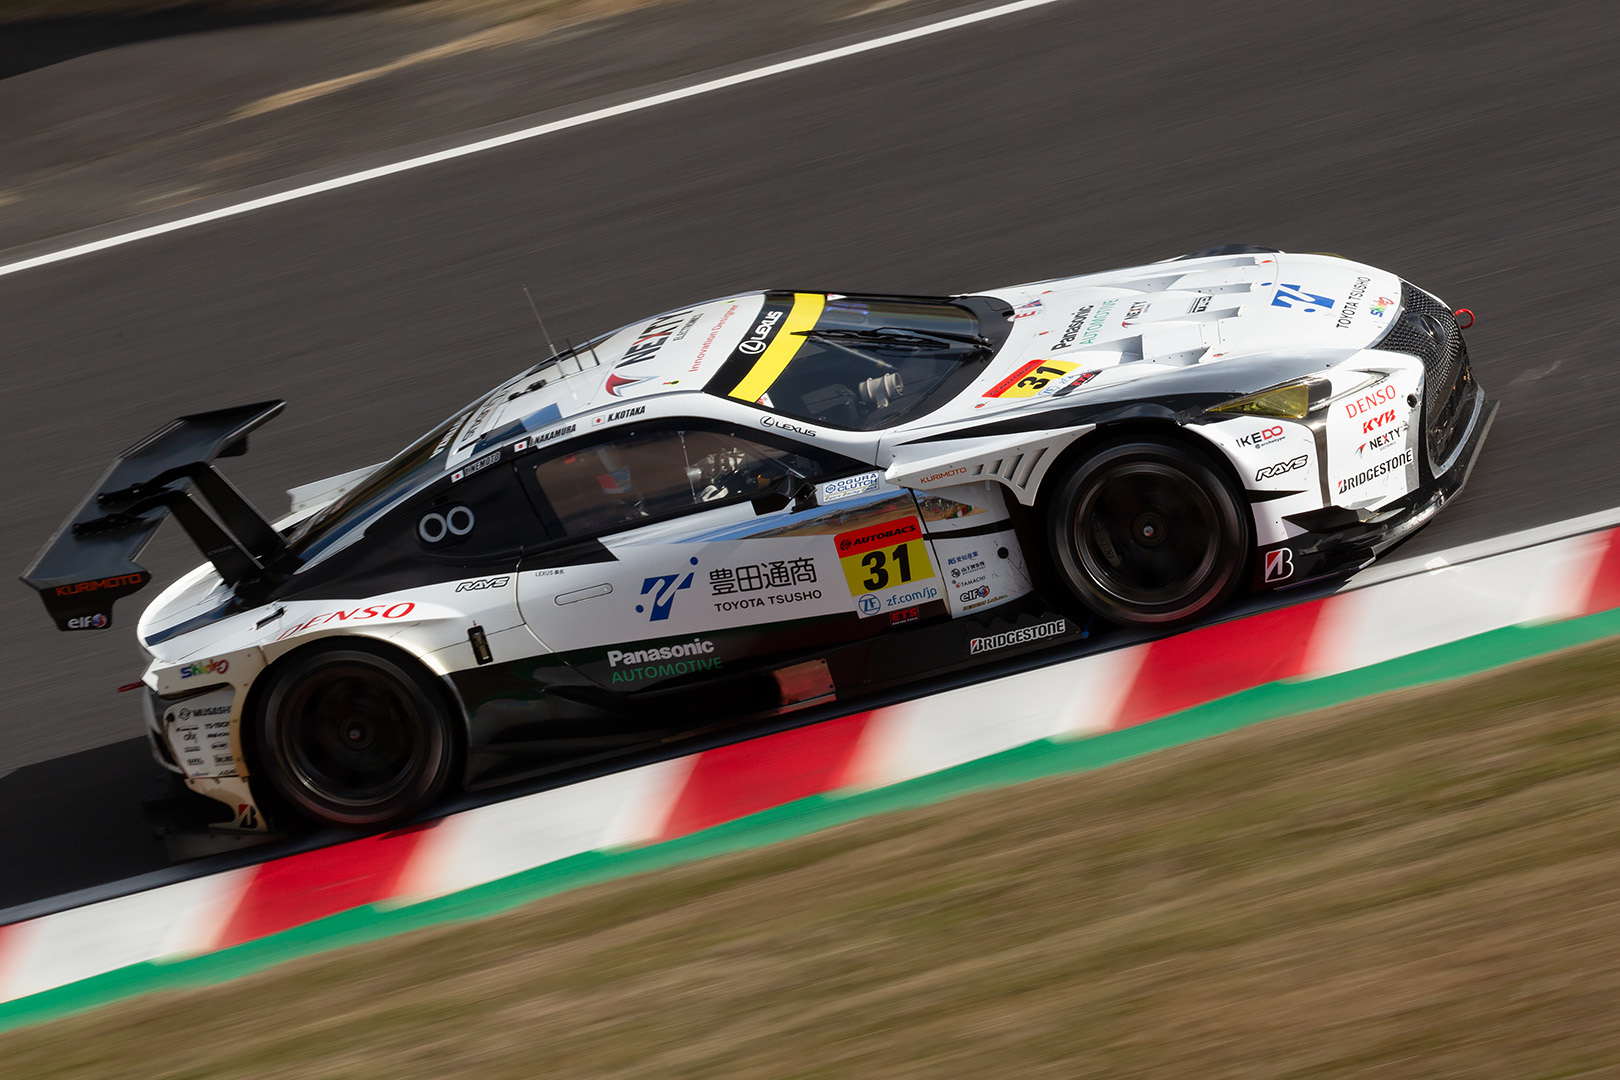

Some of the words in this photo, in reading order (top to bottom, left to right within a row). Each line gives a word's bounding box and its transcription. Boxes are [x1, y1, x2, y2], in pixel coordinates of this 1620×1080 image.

[1124, 301, 1147, 320] NEXTY
[1336, 302, 1359, 329] TOYOTA
[1348, 276, 1371, 301] TSUSHO
[751, 311, 783, 341] LEXUS
[1051, 304, 1094, 351] Panasonic
[1079, 298, 1119, 345] AUTOMOTIVE
[614, 310, 694, 369] NEXTY
[688, 329, 718, 373] Innovation
[715, 304, 739, 331] Designer
[1017, 365, 1067, 390] 31
[607, 405, 646, 423] K.KOTAKA
[1345, 384, 1396, 419] DENSO
[775, 421, 817, 438] LEXUS
[1363, 409, 1396, 434] KYB
[1235, 425, 1284, 448] IKEDO
[1369, 427, 1401, 451] NEXTY
[837, 472, 877, 487] OGURA
[920, 466, 968, 484] KURIMOTO
[1255, 454, 1309, 482] RAYS
[1337, 449, 1414, 495] BRIDGESTONE
[837, 477, 879, 493] CLUTCH
[853, 524, 917, 546] AUTOBACS
[709, 557, 818, 596] 豊田通商
[861, 543, 912, 591] 31
[55, 573, 142, 597] KURIMOTO
[455, 576, 511, 592] RAYS
[886, 586, 938, 607] zf.com/jp
[960, 588, 979, 602] elf
[714, 597, 766, 612] TOYOTA
[768, 589, 823, 607] TSUSHO
[67, 615, 93, 629] elf
[276, 602, 416, 641] DENSO
[891, 607, 918, 621] ETS
[970, 618, 1067, 655] BRIDGESTONE
[607, 638, 715, 667] Panasonic
[612, 657, 724, 684] AUTOMOTIVE
